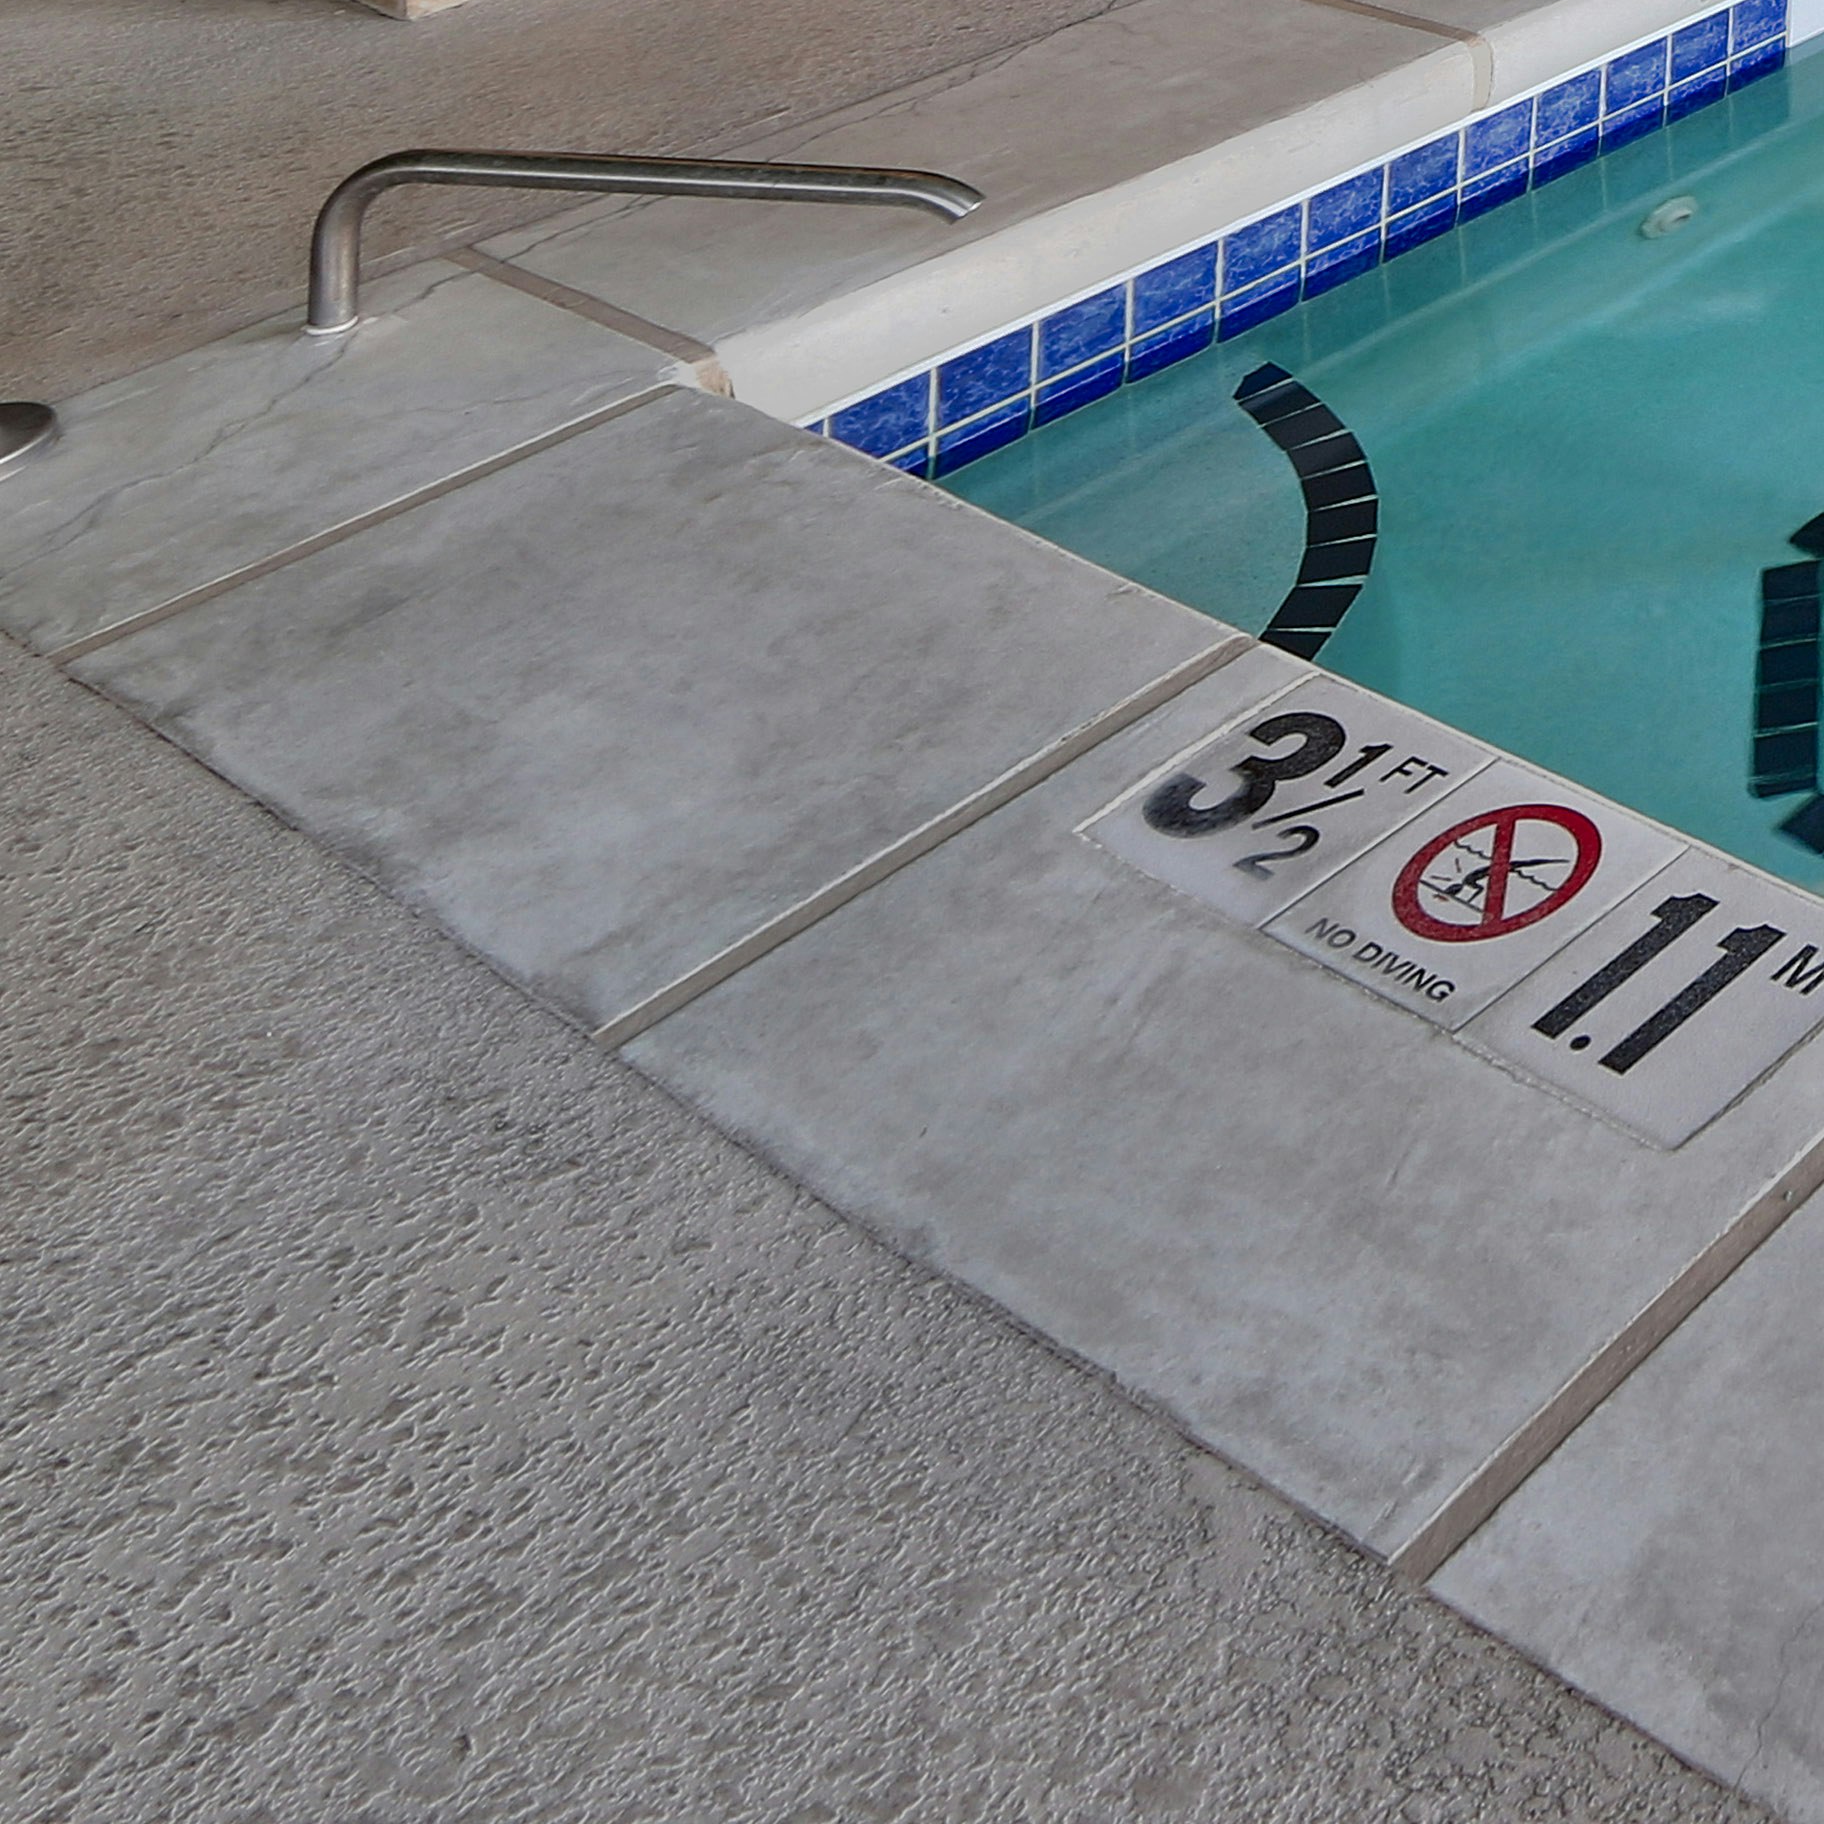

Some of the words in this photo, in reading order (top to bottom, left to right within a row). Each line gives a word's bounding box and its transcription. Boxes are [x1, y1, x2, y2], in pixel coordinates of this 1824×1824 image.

[1379, 756, 1449, 794] FT
[1305, 916, 1358, 951] NO
[1350, 938, 1459, 1005] DIVING
[1530, 892, 1787, 1076] 1.1
